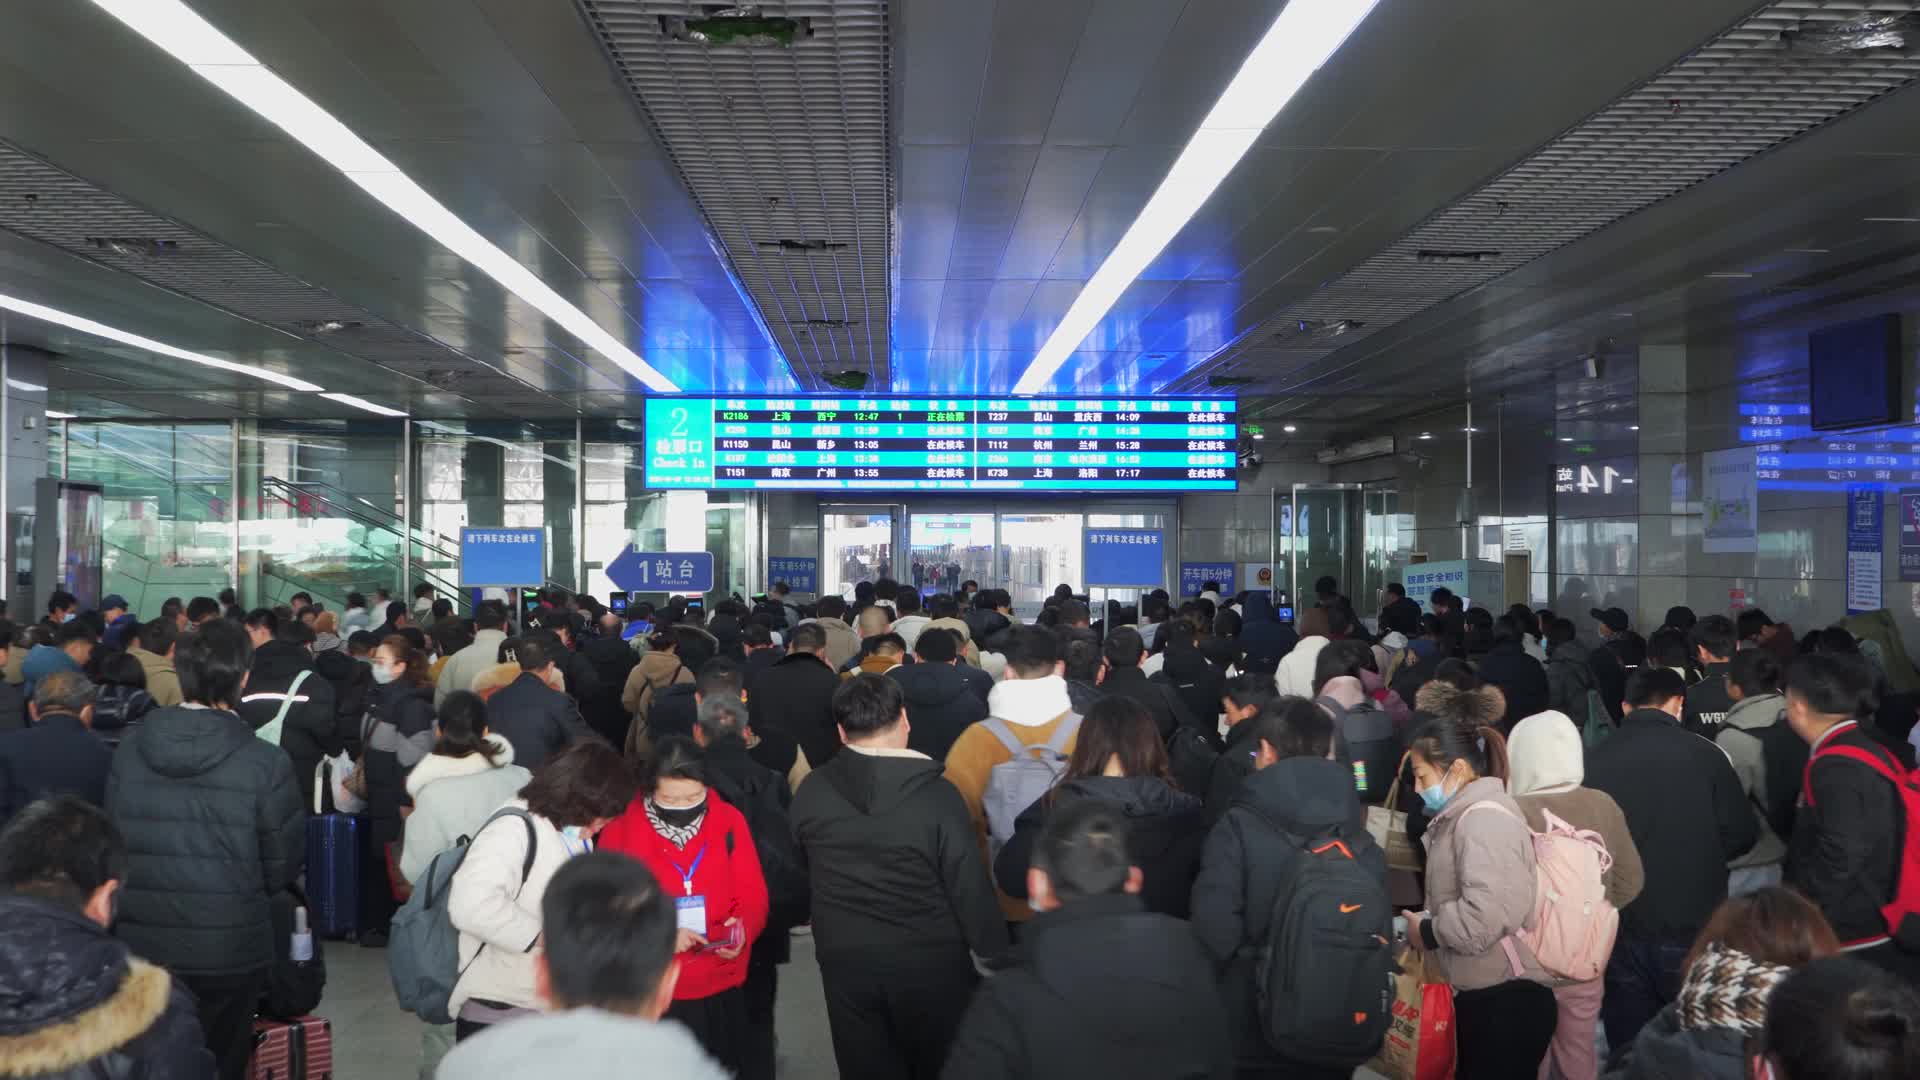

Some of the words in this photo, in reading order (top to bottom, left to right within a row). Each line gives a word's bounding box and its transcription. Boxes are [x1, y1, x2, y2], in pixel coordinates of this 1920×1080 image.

[671, 407, 689, 436] 2
[723, 412, 749, 421] K2186
[772, 412, 791, 422] 上海
[817, 412, 837, 422] 西宁
[854, 412, 879, 421] 12:47
[897, 412, 902, 421] 1
[926, 412, 965, 422] 正在检票
[988, 412, 1008, 422] T237
[1034, 412, 1053, 422] 昆山
[1074, 412, 1102, 422] 重庆西
[1116, 413, 1140, 422] 14:09
[1188, 413, 1226, 423] 在此候车
[723, 440, 749, 450] K1150
[772, 440, 791, 450] 昆山
[817, 440, 836, 450] 新乡
[854, 440, 878, 450] 13:05
[927, 440, 965, 450] 在此候车
[988, 440, 1008, 450] T112
[1034, 440, 1053, 450] 杭州
[1078, 440, 1098, 450] 兰州
[1116, 441, 1140, 450] 15:28
[1188, 441, 1226, 450] 在此候车
[726, 468, 745, 477] T151
[771, 468, 791, 478] 南京
[817, 468, 836, 478] 广州
[854, 468, 878, 478] 13:55
[926, 468, 965, 478] 在此候车
[988, 468, 1008, 478] K738
[1034, 468, 1053, 478] 上海
[1078, 468, 1098, 478] 洛阳
[1116, 469, 1140, 478] 17:17
[1188, 469, 1226, 478] 在此候车
[1090, 535, 1158, 544] 请下列车次在此候车
[639, 560, 648, 584] 1
[1184, 568, 1232, 581] 开车前5分钟
